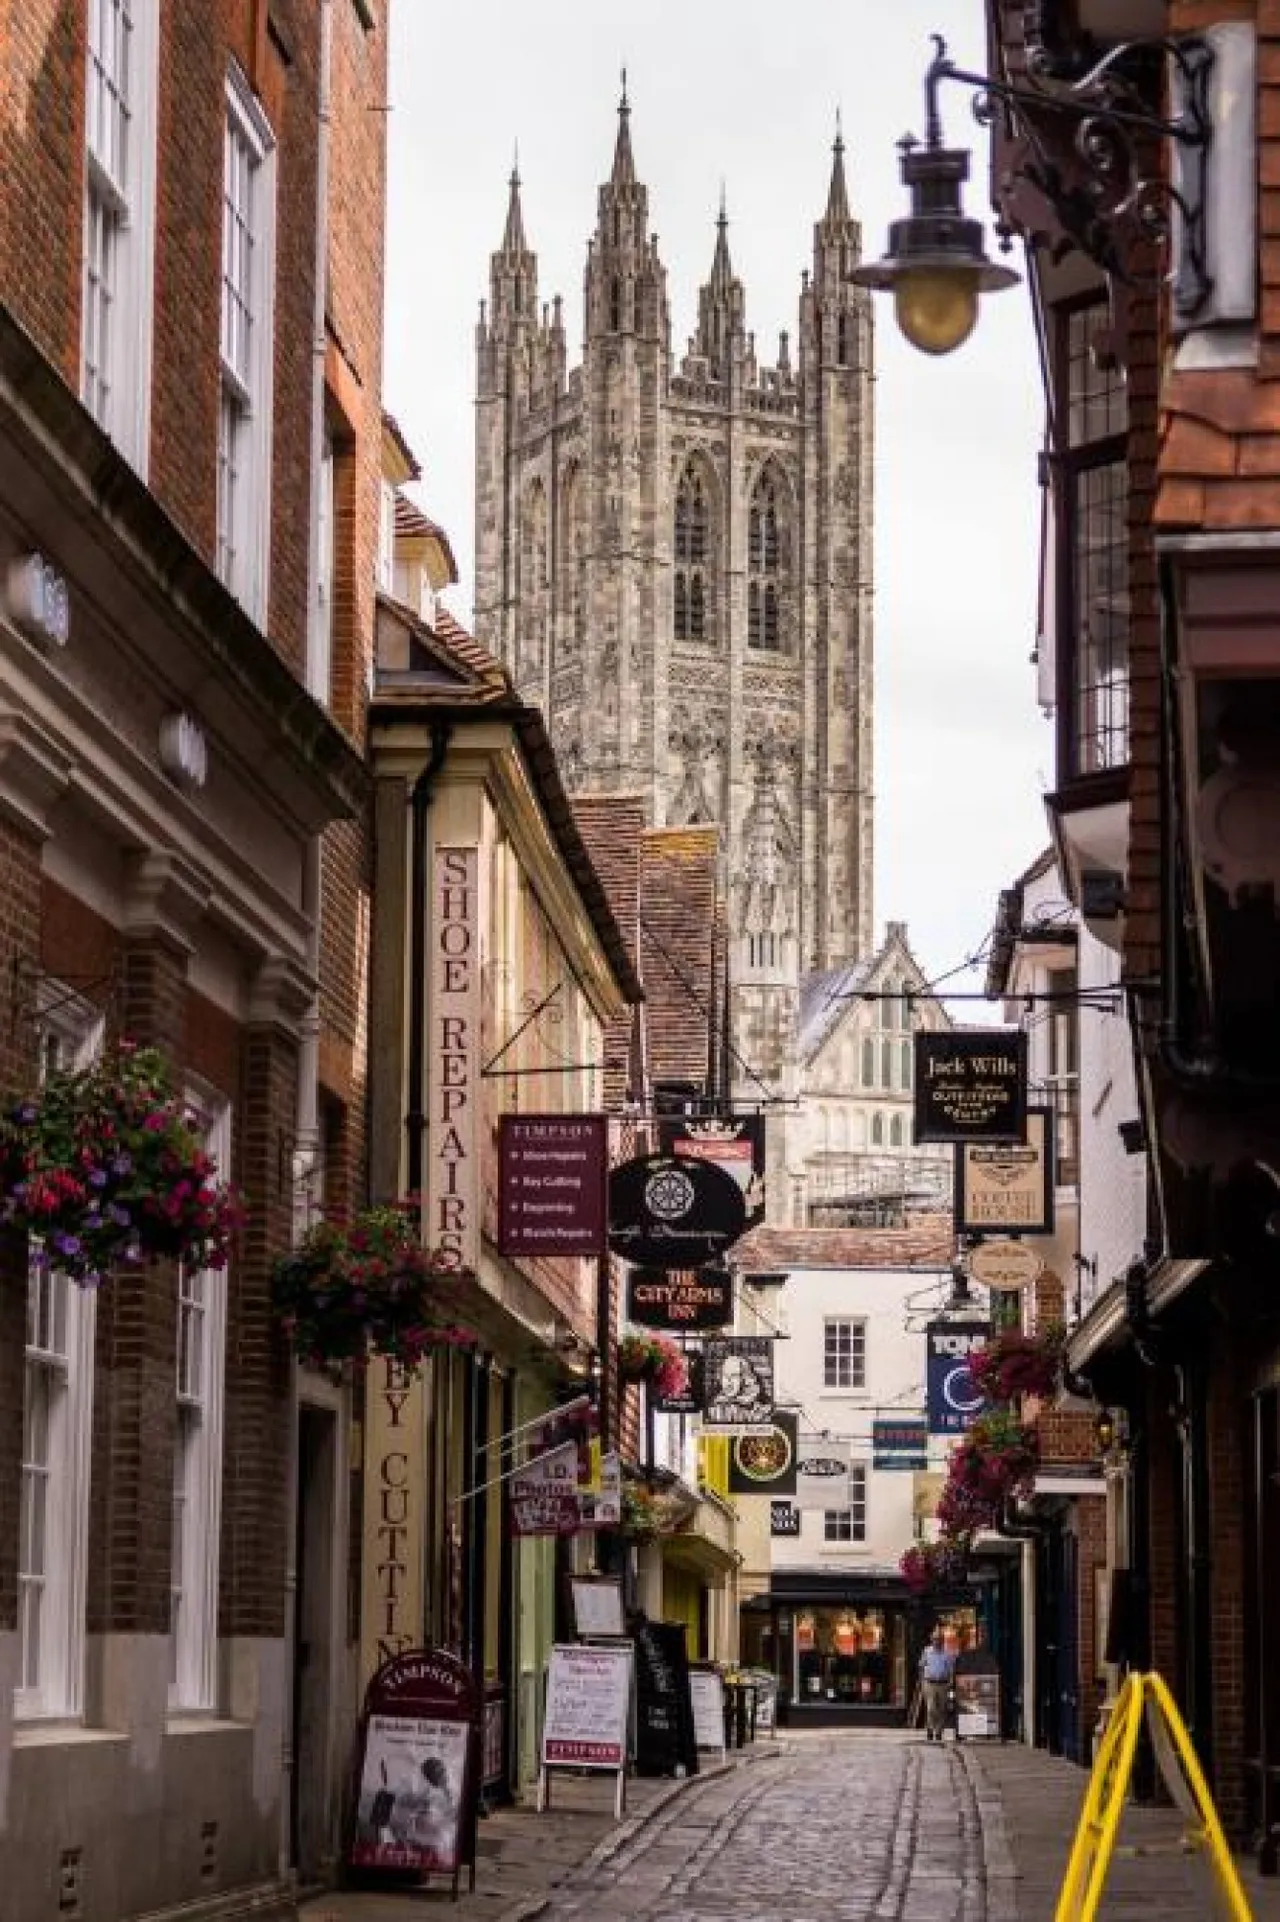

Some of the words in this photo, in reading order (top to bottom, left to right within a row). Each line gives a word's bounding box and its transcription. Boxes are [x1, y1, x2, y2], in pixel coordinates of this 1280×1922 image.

[440, 852, 469, 993] SHOE
[924, 1056, 965, 1078] Jack
[969, 1056, 1017, 1075] Wills
[435, 1017, 469, 1268] REPAIRS
[635, 1286, 674, 1301] CITY
[675, 1286, 724, 1302] ARMS
[666, 1270, 696, 1286] THE
[668, 1304, 696, 1319] INN
[384, 1355, 411, 1428] EY
[377, 1452, 412, 1668] CUTTIN
